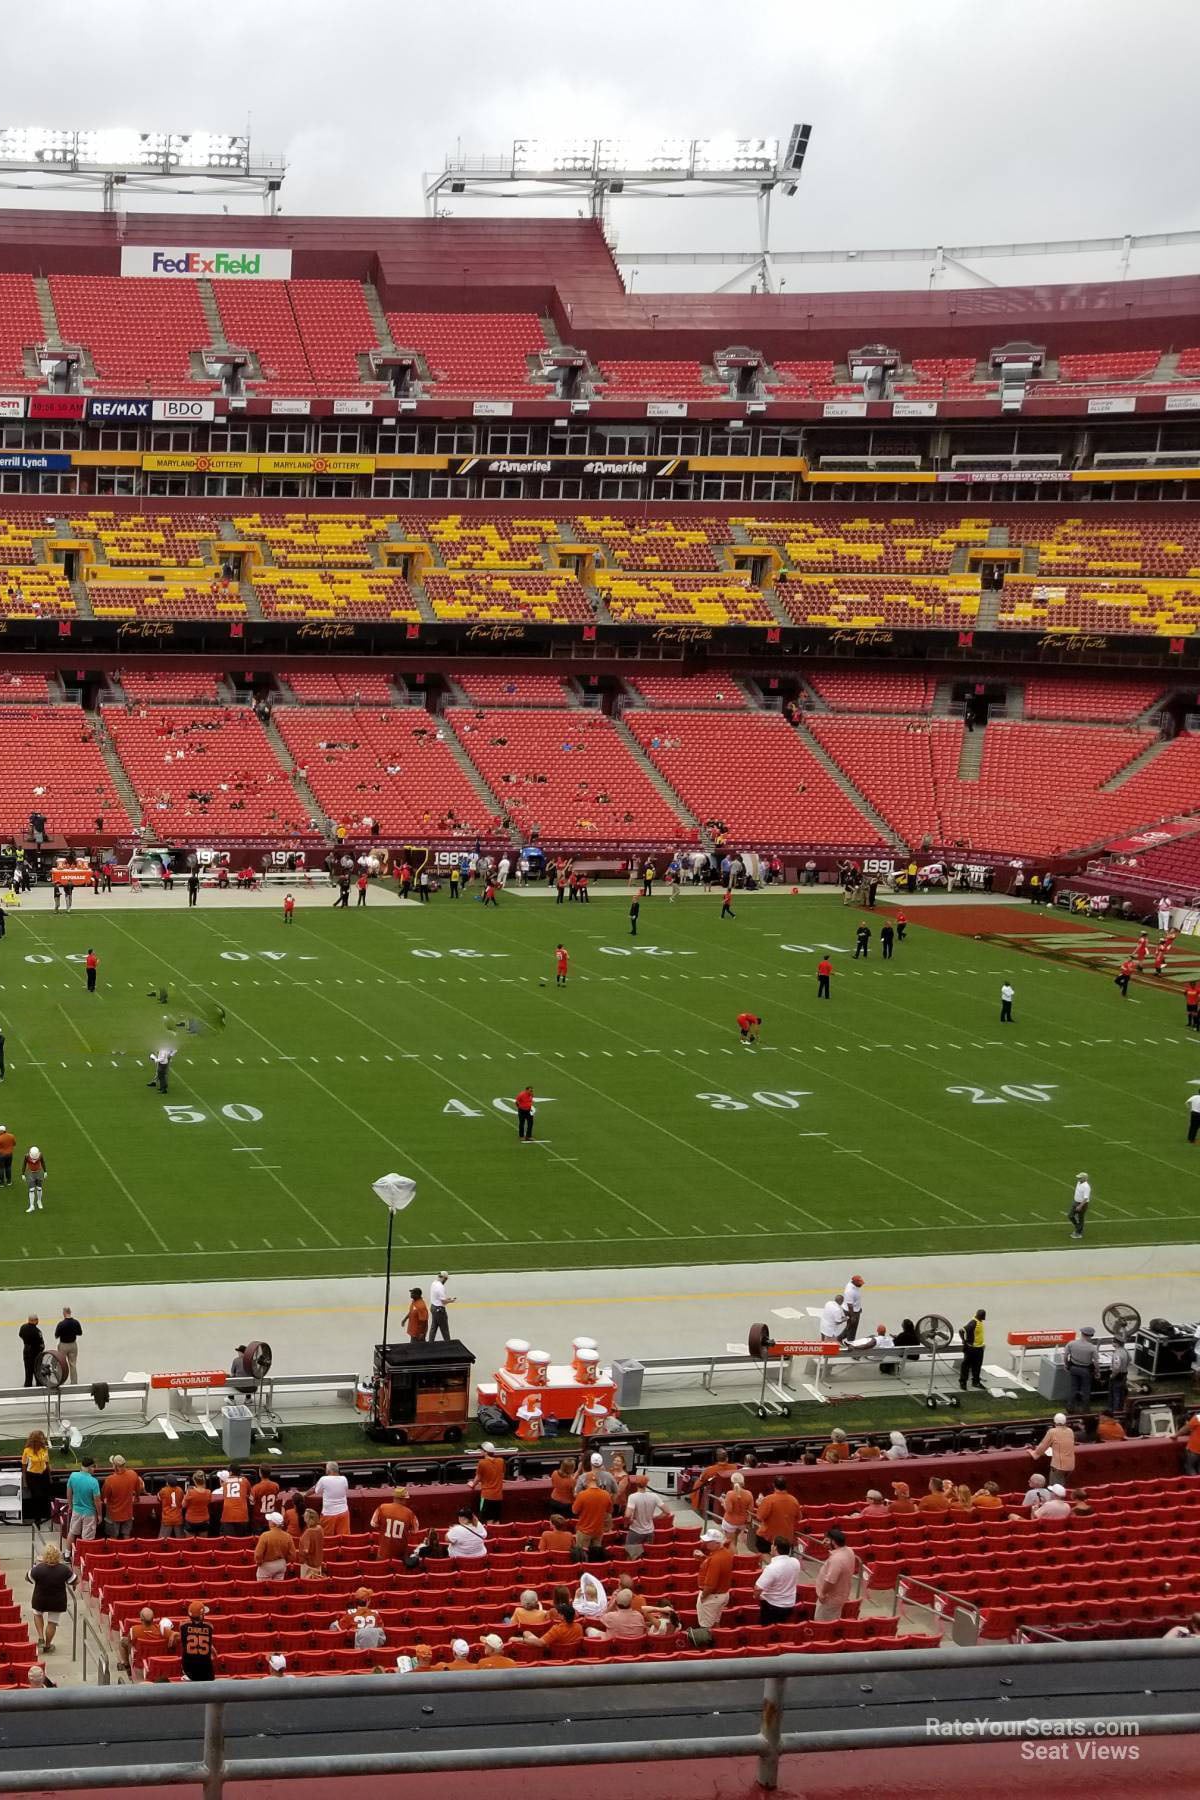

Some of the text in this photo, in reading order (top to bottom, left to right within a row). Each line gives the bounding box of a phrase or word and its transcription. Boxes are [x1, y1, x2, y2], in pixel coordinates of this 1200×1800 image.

[152, 252, 261, 274] FedExField
[92, 403, 148, 416] RE/MAX
[168, 402, 203, 416] BDO
[22, 456, 48, 468] Lynch
[156, 459, 194, 467] MARYLAND
[328, 462, 360, 470] LOTTERY
[498, 460, 551, 472] Ameritel
[594, 461, 647, 473] Ameritel
[862, 859, 895, 873] 1991
[696, 1091, 800, 1111] 30
[946, 1084, 1051, 1104] 20
[162, 1104, 264, 1123] 50
[1026, 1334, 1064, 1343] GATORADE
[784, 1344, 824, 1354] GATORADE
[170, 1376, 212, 1385] GATORADE
[226, 1483, 240, 1498] 12
[170, 1492, 177, 1508] 1
[260, 1494, 276, 1512] 12
[386, 1518, 404, 1538] 10
[186, 1635, 210, 1654] 25
